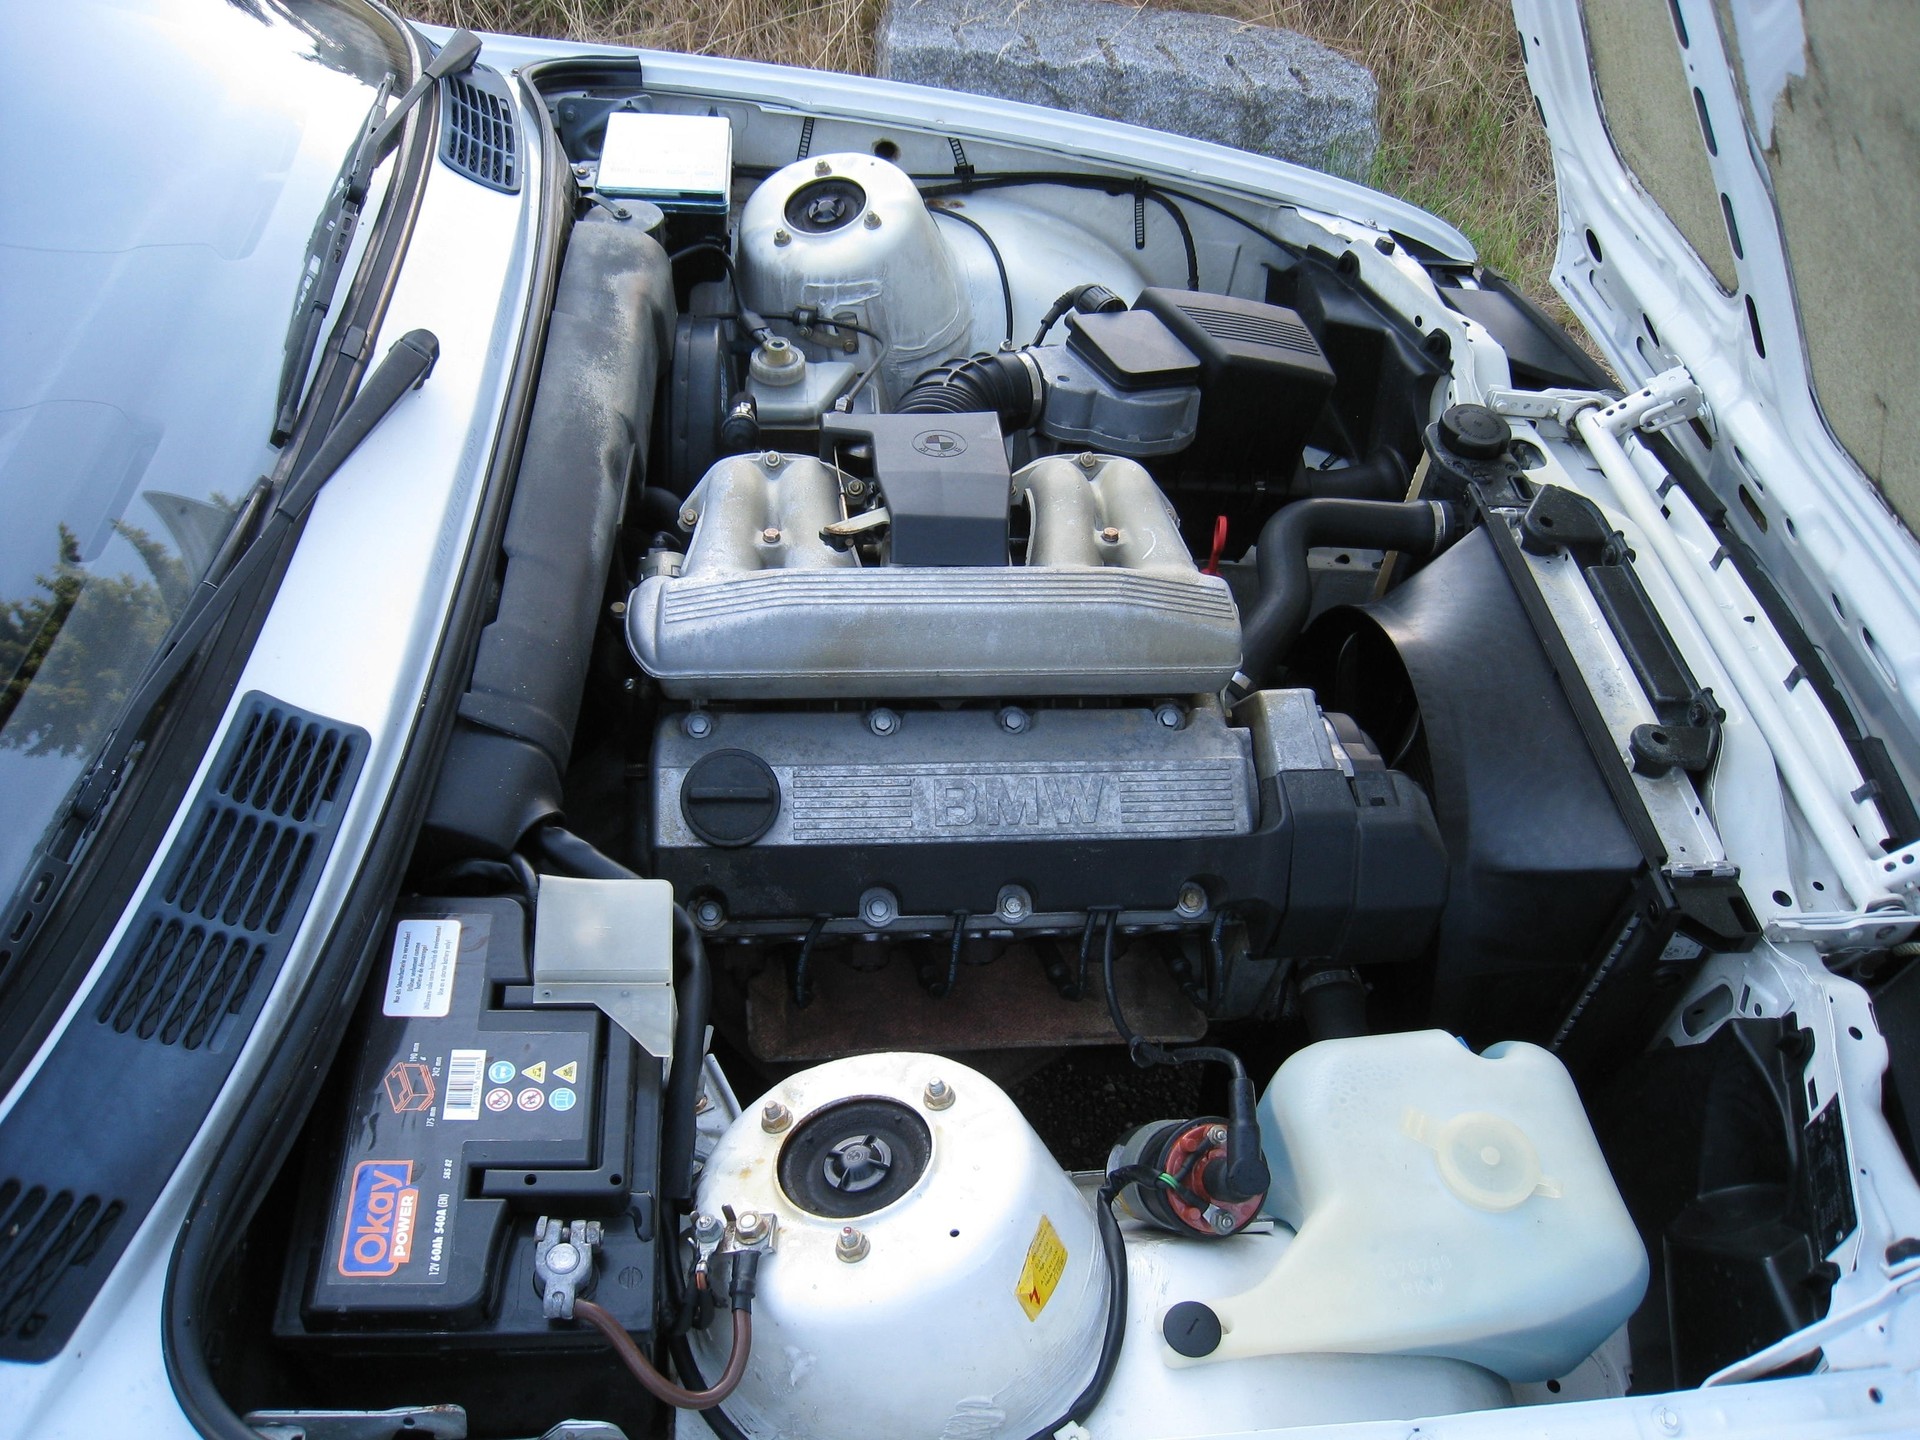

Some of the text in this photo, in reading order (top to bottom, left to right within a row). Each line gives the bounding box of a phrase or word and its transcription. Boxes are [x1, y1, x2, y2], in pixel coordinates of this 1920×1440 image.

[934, 776, 1105, 828] BMW
[409, 1042, 420, 1062] 190 mm
[431, 1056, 443, 1077] 242 mm
[426, 1106, 436, 1127] 175 mm
[354, 1170, 403, 1263] Okay
[393, 1195, 414, 1256] POWER
[429, 1193, 450, 1275] 12V 60Ah 540A (EN)
